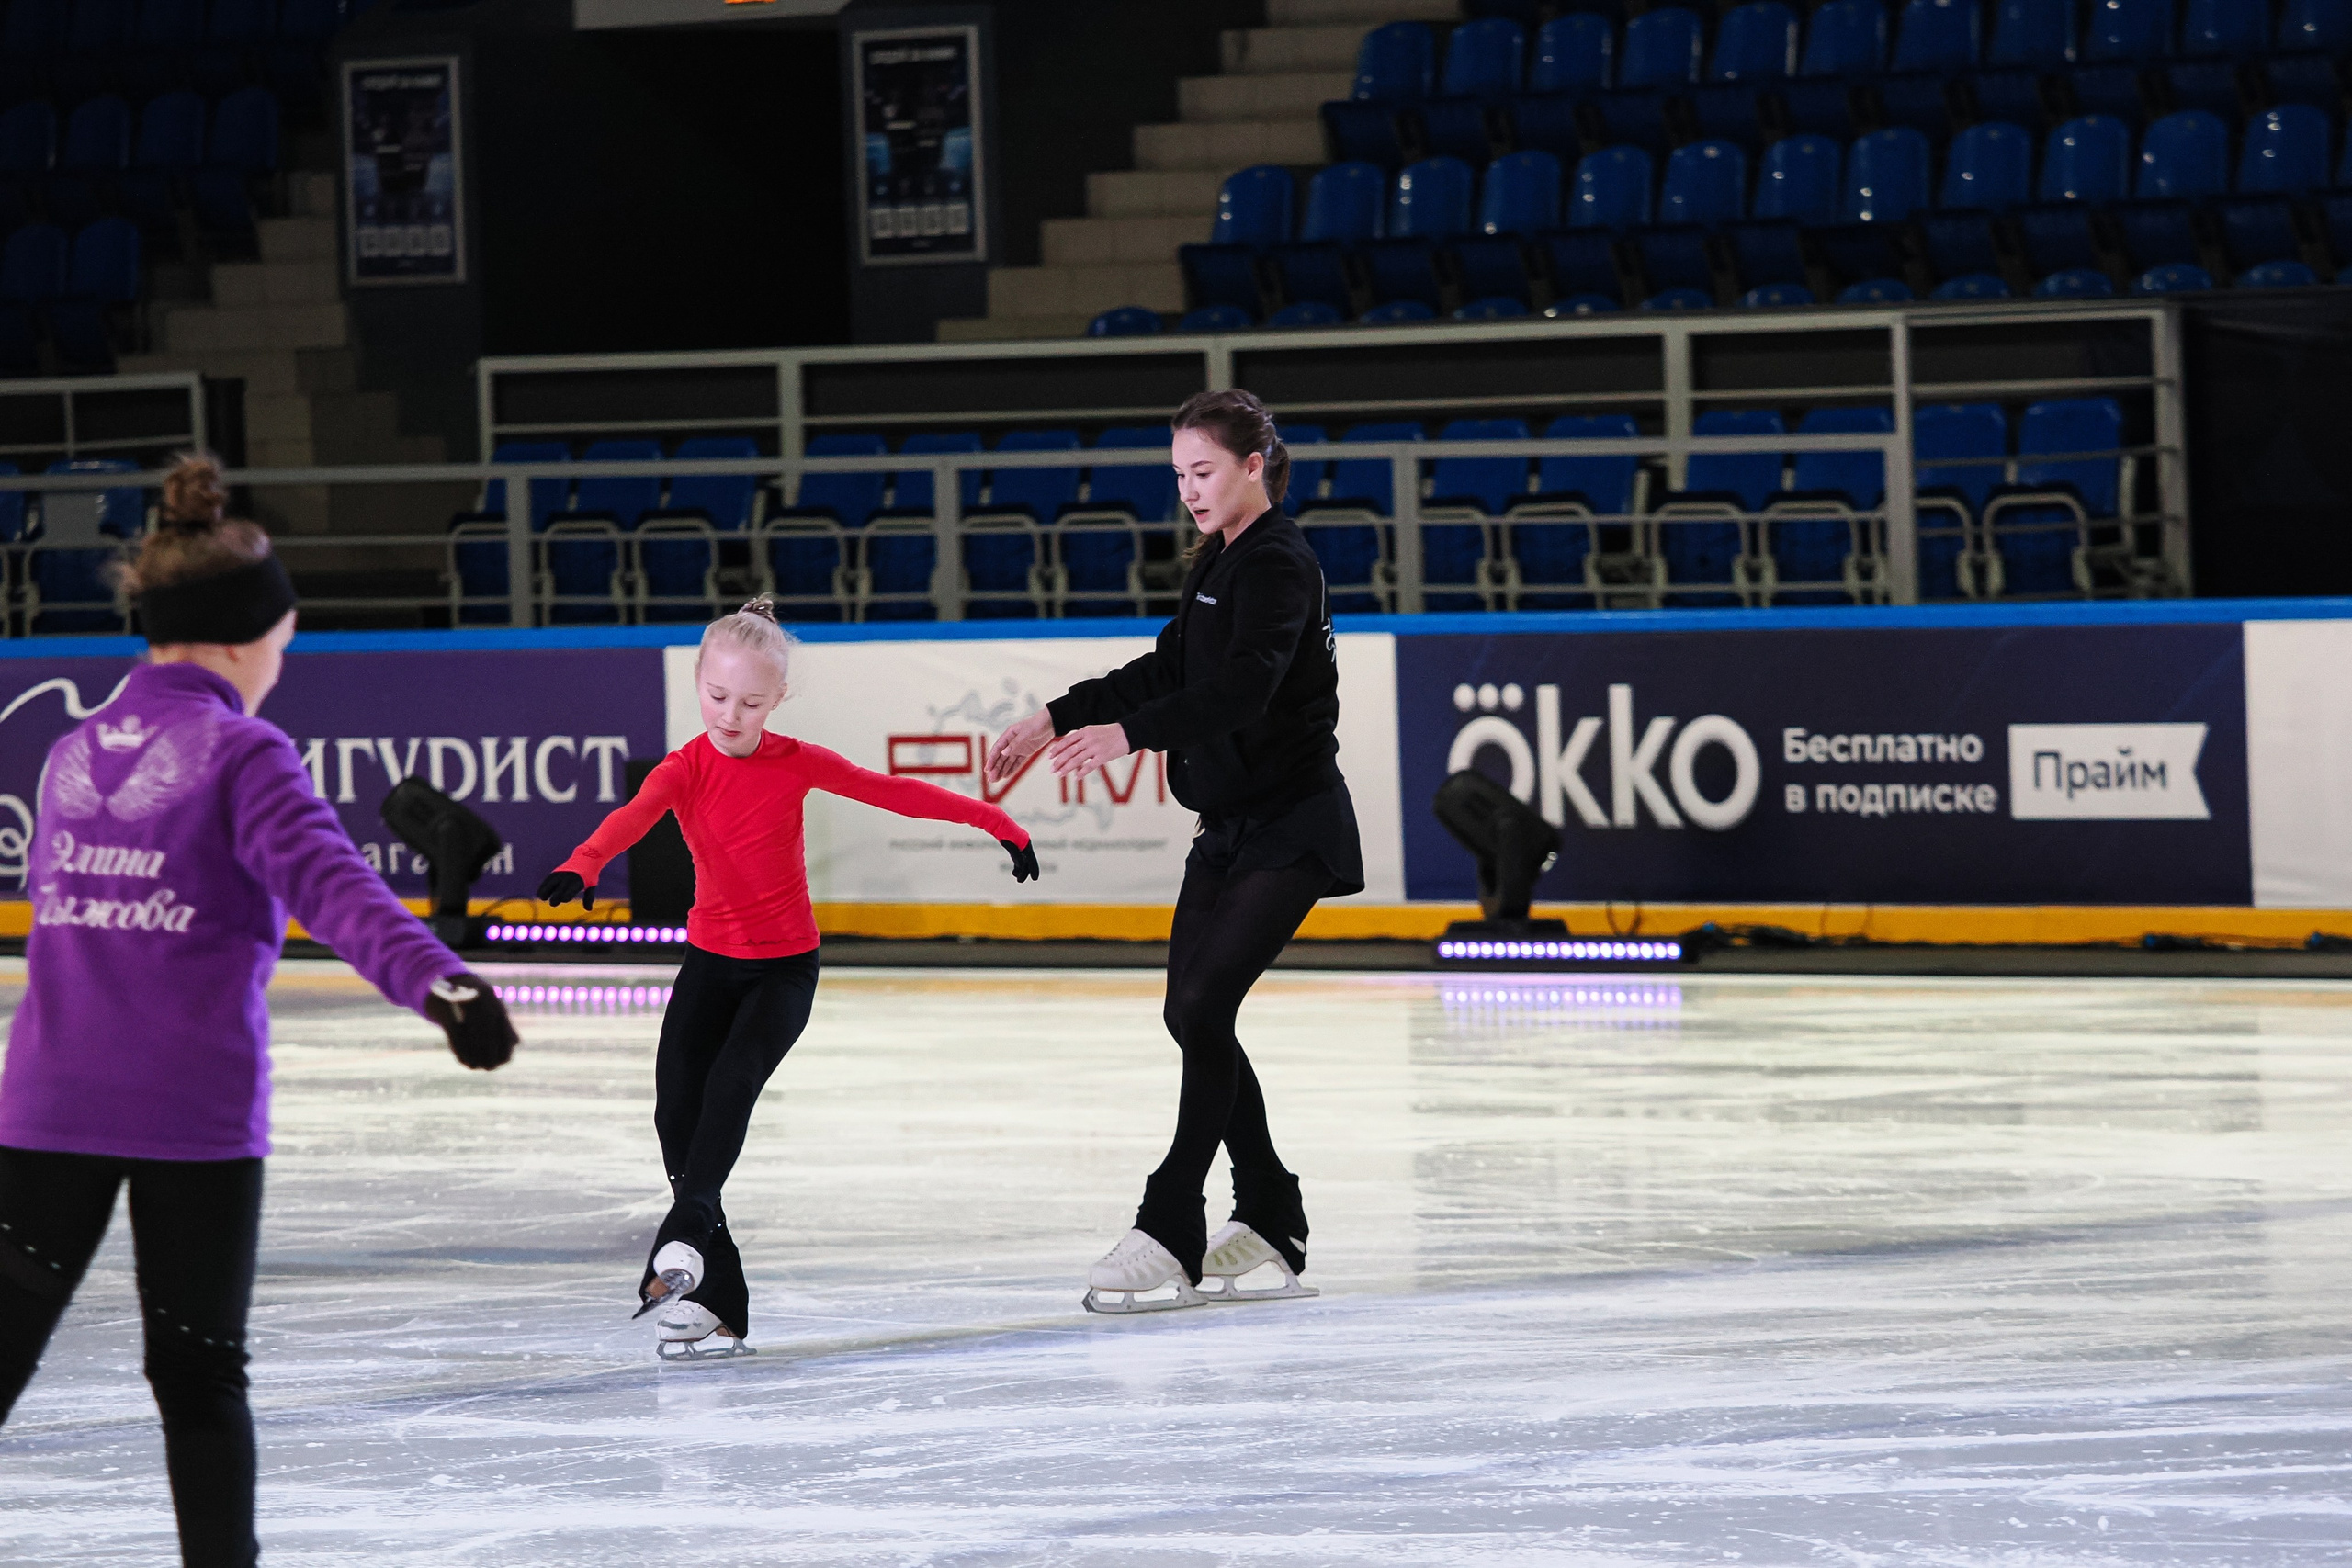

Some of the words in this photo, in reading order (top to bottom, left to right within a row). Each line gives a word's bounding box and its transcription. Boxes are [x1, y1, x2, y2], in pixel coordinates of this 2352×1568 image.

[1782, 727, 1984, 764] Бесплатно
[2033, 746, 2168, 799] Прайм
[1784, 785, 1806, 813] в
[1815, 784, 1999, 818] подписке
